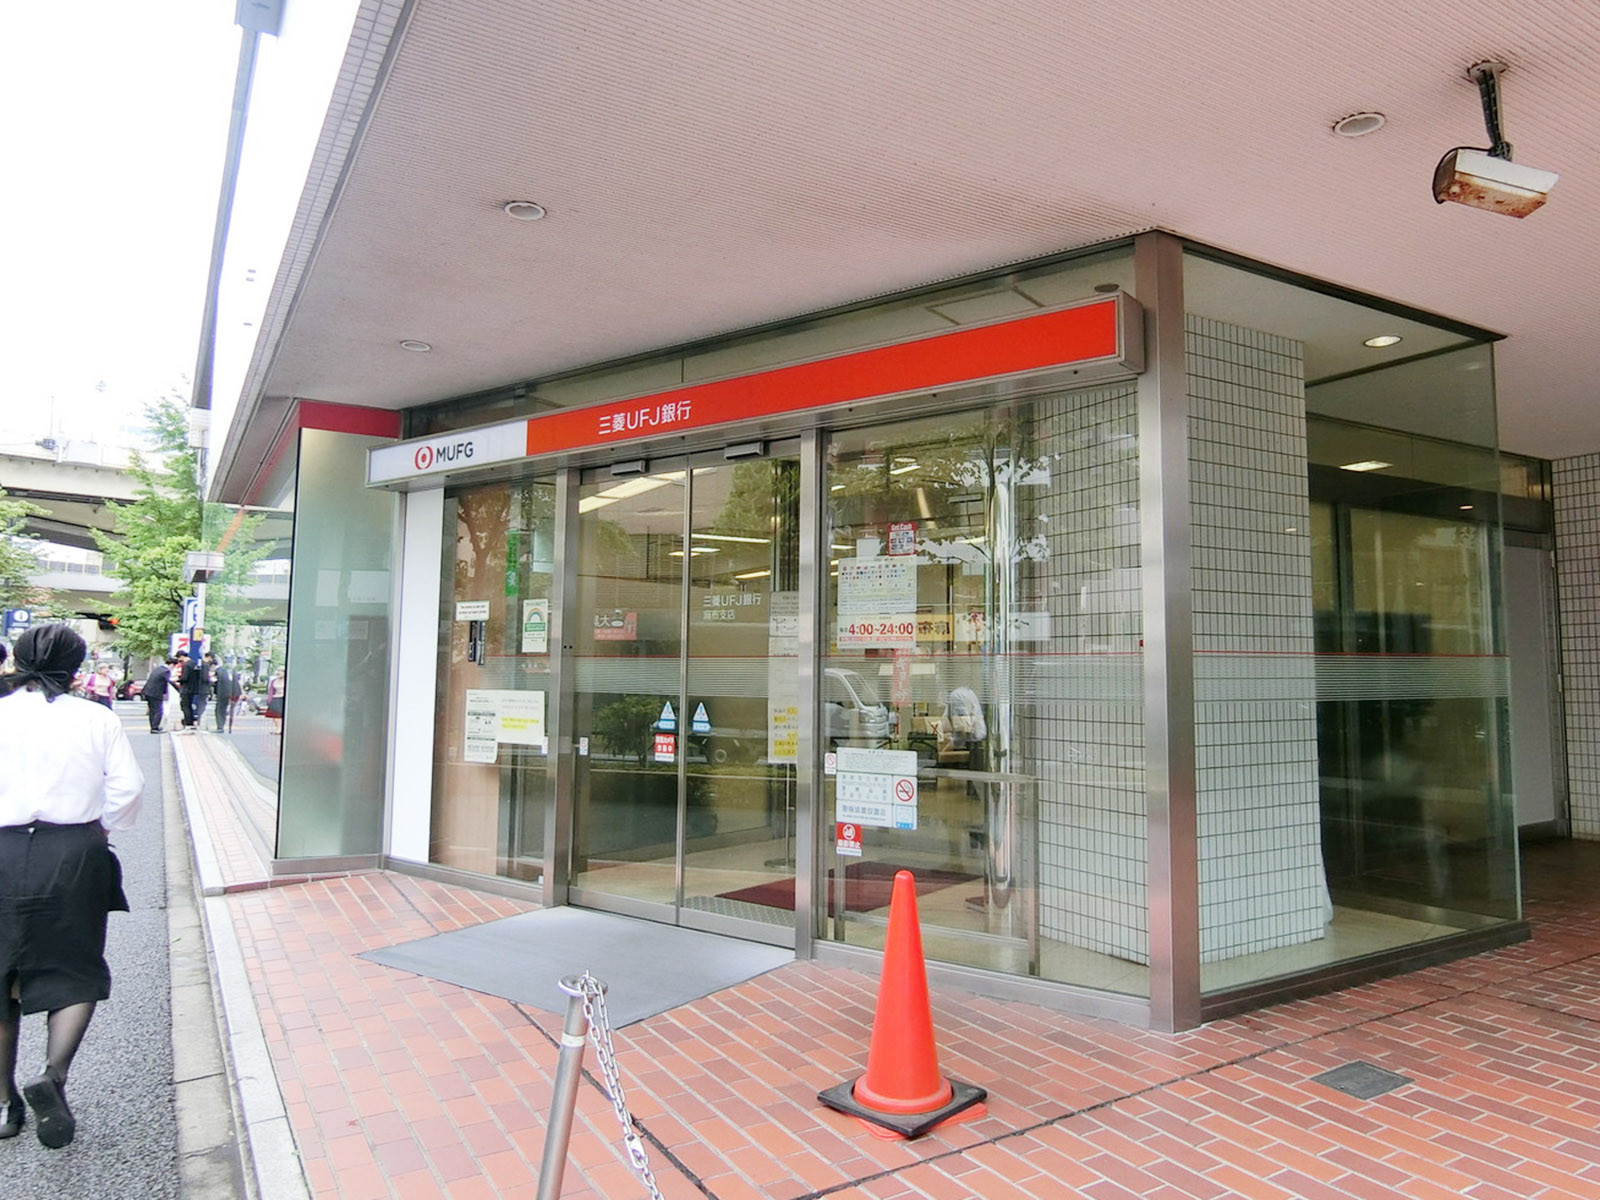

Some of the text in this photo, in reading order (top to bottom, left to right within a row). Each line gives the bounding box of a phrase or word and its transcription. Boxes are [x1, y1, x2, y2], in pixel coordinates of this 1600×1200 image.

[598, 400, 691, 434] 三菱UFJ銀行
[436, 441, 473, 463] MUFG
[703, 593, 762, 607] 三菱UFJ銀行
